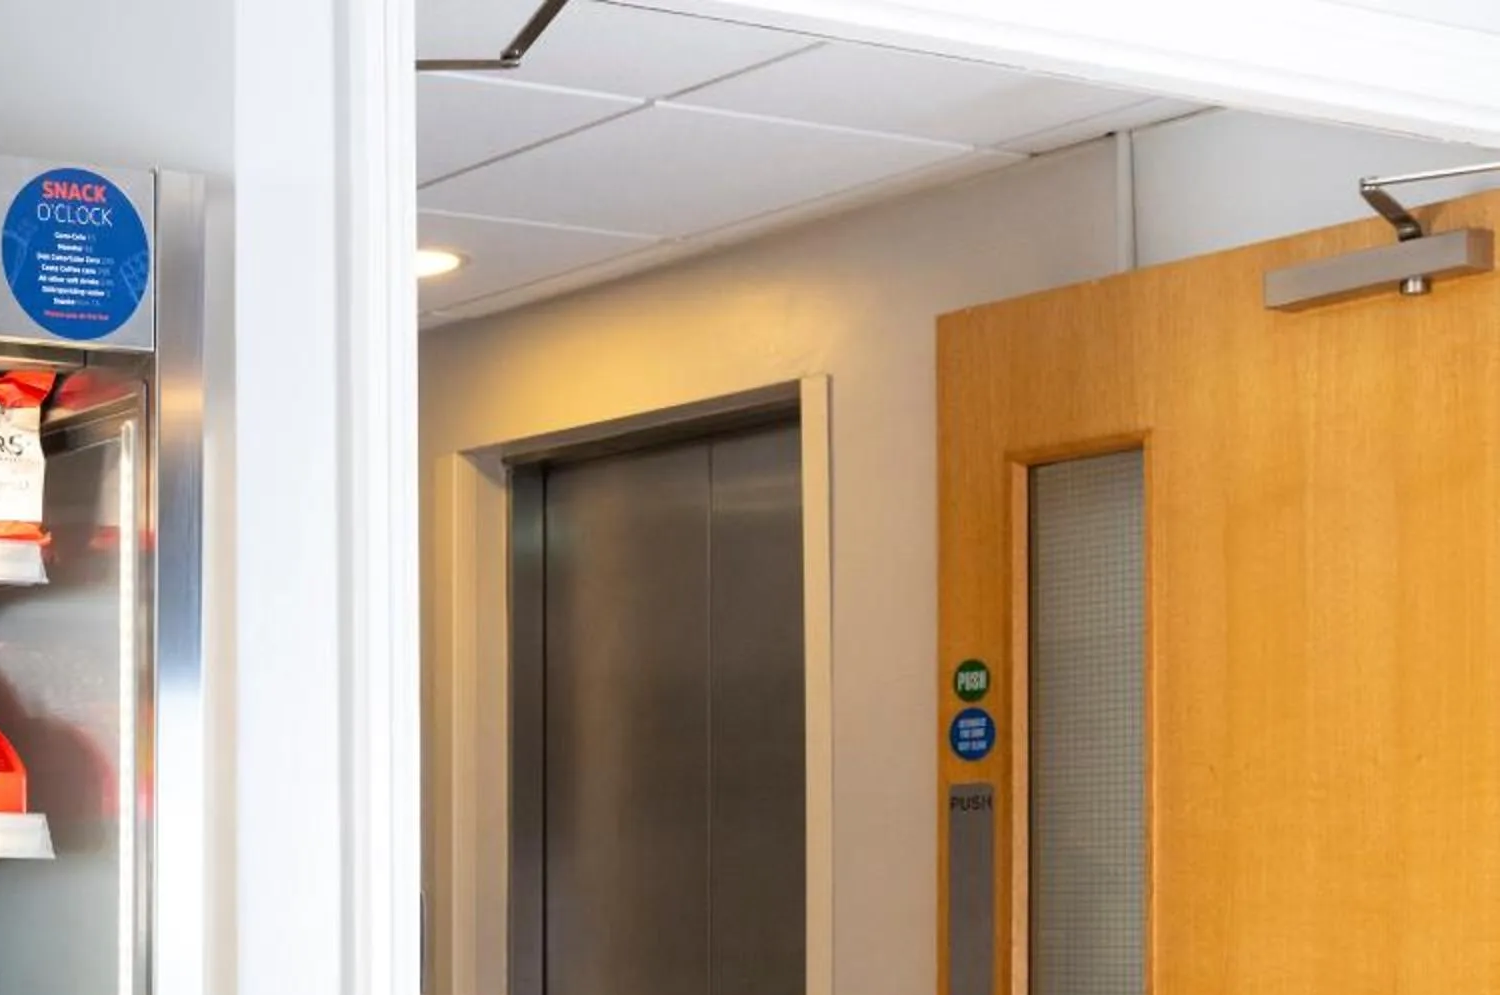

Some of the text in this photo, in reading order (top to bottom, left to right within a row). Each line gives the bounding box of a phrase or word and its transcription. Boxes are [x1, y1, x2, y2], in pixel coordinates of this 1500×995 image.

[42, 180, 106, 203] SNACK
[37, 202, 113, 227] O'CLOCK
[957, 670, 987, 692] PUSH
[950, 794, 993, 811] PUSH
